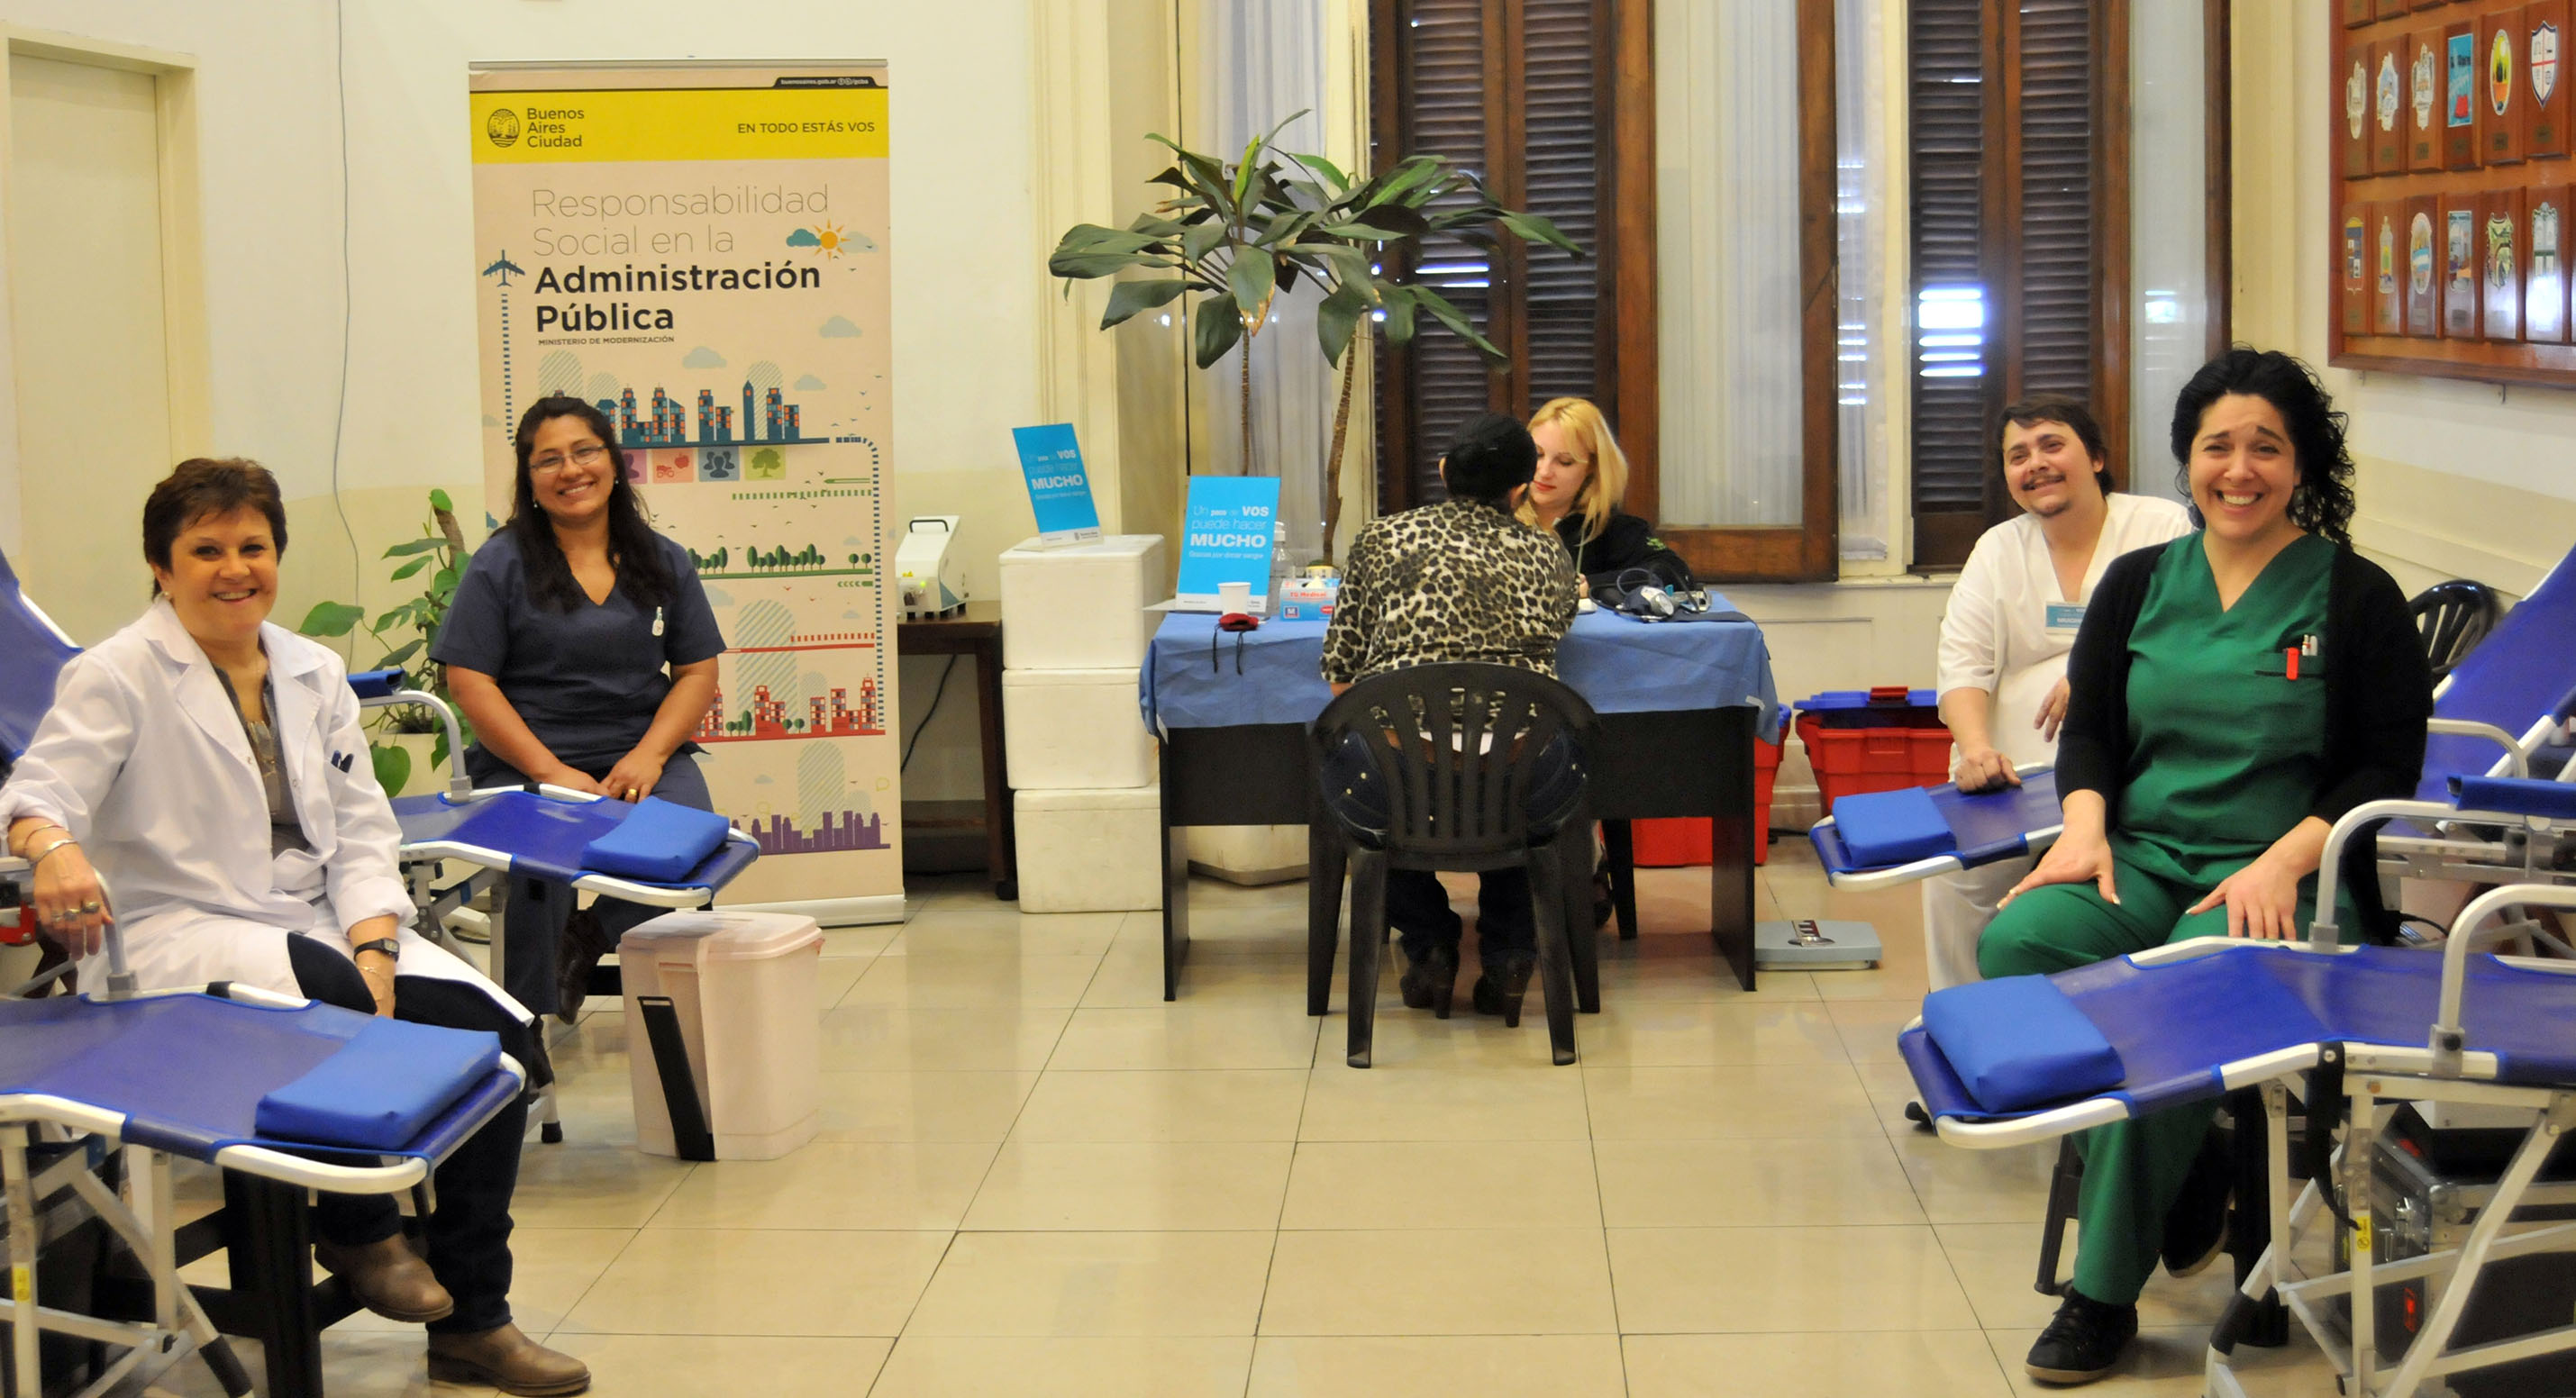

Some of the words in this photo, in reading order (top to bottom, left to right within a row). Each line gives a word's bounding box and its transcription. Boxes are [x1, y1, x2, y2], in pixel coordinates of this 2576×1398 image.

[527, 107, 585, 120] Buenos
[527, 121, 567, 134] Aires
[737, 123, 756, 134] EN
[760, 123, 798, 133] TODO
[802, 119, 844, 133] ESTÁS
[847, 122, 876, 132] VOS
[527, 134, 583, 148] Ciudad
[532, 183, 829, 222] Responsabilidad
[532, 225, 638, 256] Social
[651, 231, 694, 254] en
[707, 223, 734, 253] la
[534, 259, 821, 295] Administración
[536, 302, 674, 332] Pública
[538, 338, 587, 346] MINISTERIO
[589, 337, 601, 345] DE
[603, 335, 675, 345] MODERNIZACIÓN
[1031, 474, 1084, 490] MUCHO
[1190, 533, 1266, 548] MUCHO
